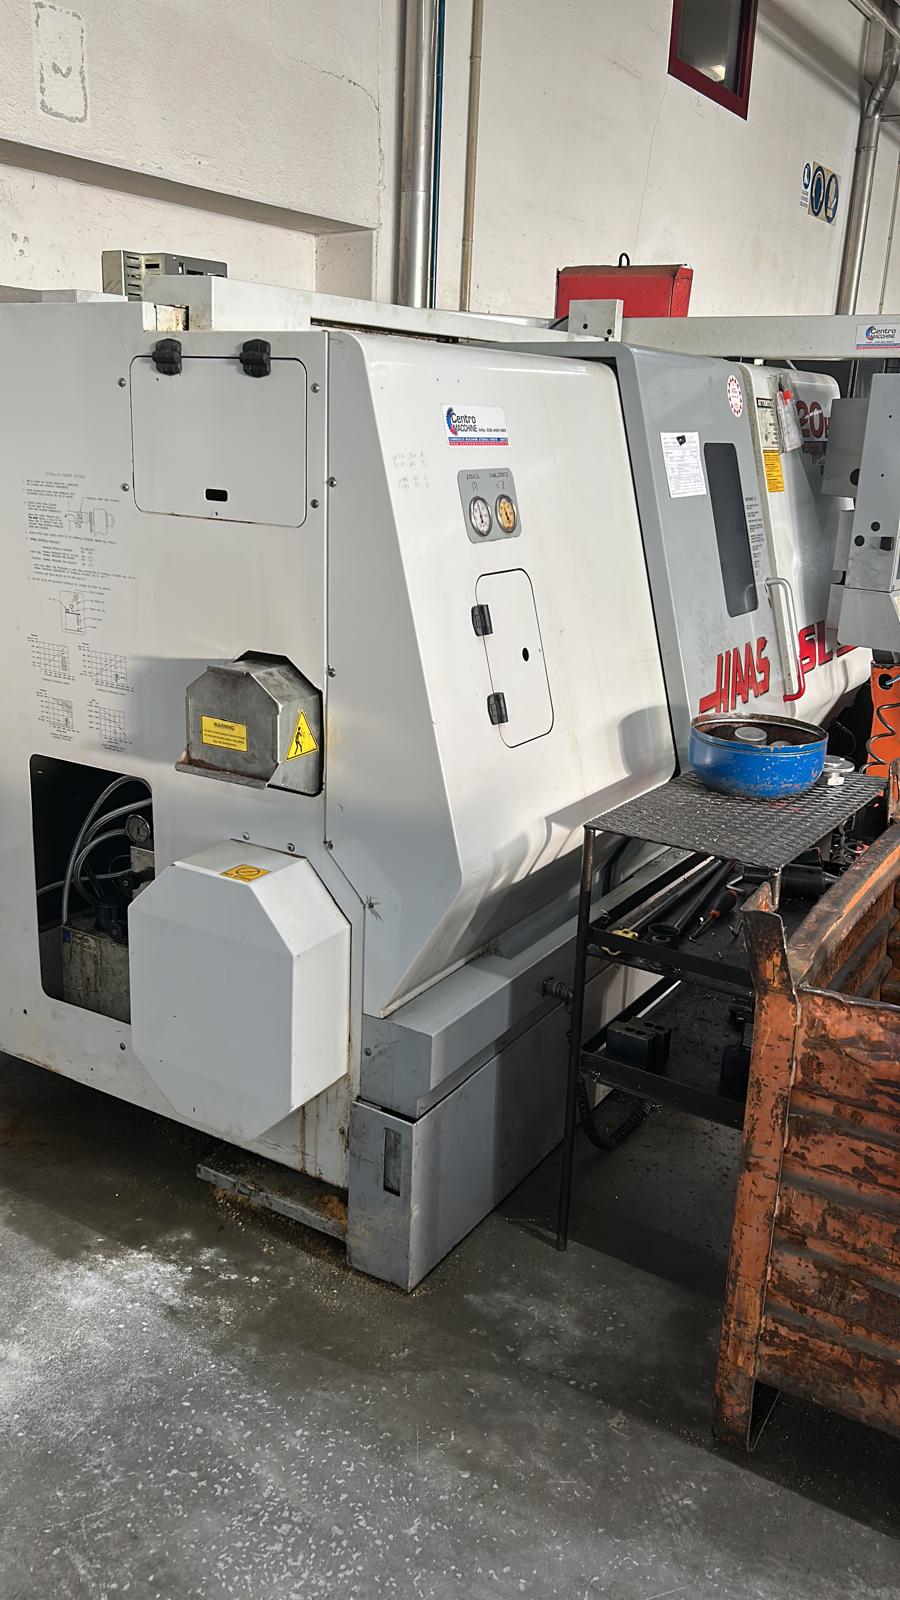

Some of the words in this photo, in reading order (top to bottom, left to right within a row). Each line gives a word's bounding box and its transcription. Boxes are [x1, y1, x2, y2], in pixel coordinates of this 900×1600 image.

[870, 326, 896, 334] Centro
[451, 413, 476, 423] Centro
[700, 636, 771, 714] HAAS
[213, 721, 236, 732] WARNING
